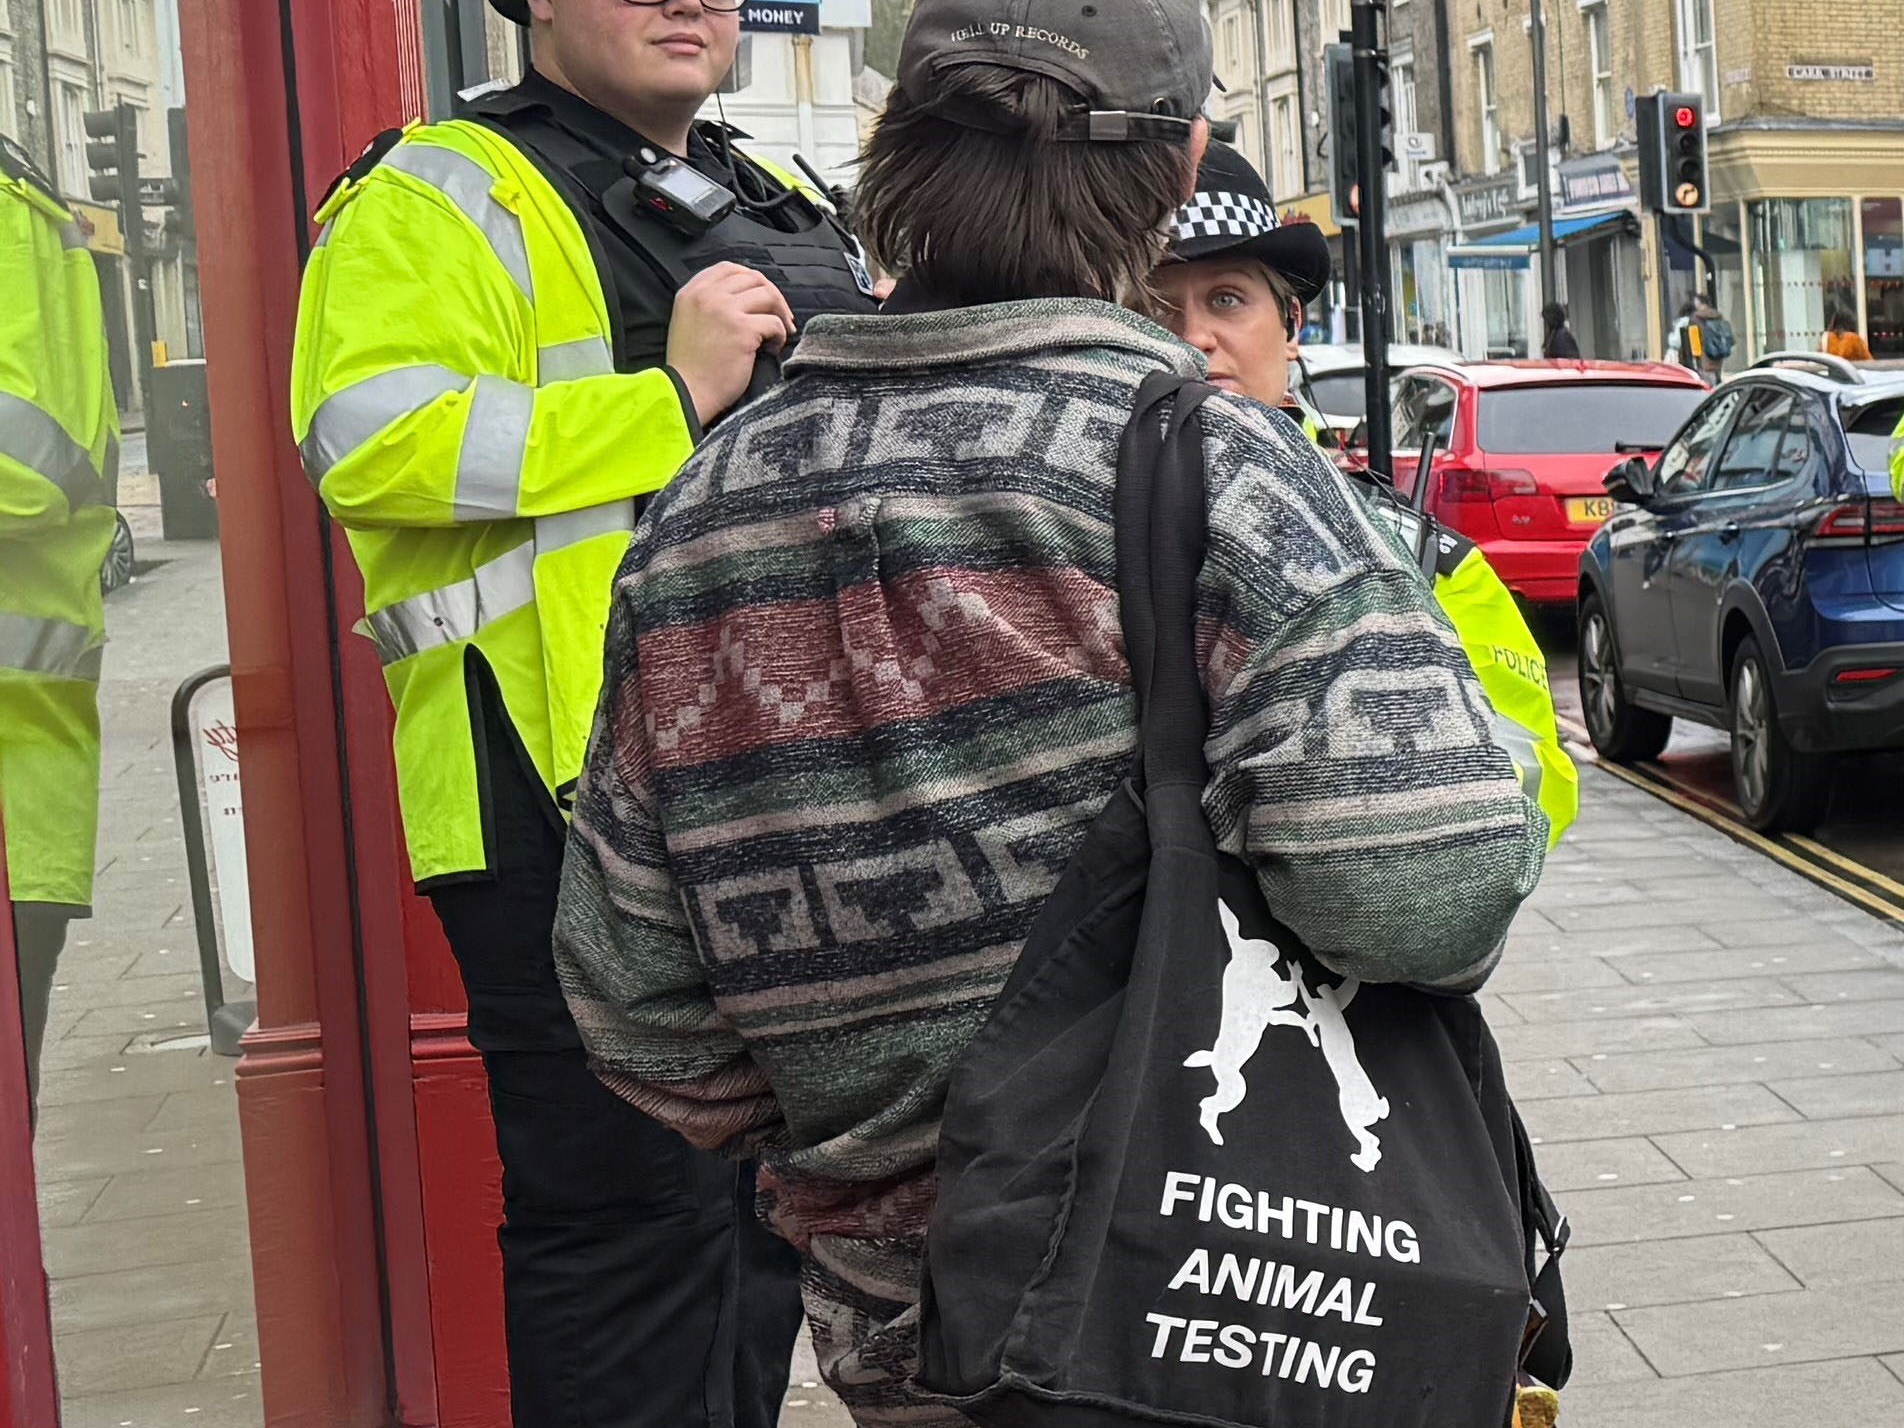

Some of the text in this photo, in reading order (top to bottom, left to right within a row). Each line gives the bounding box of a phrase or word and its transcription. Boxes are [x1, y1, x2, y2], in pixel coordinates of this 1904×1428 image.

[748, 8, 804, 25] MONEY
[990, 22, 1010, 36] UP
[1015, 25, 1090, 60] RECORDS
[1584, 499, 1615, 517] KB
[1160, 1171, 1422, 1265] FIGHTING
[1168, 1247, 1384, 1327] ANIMAL
[1144, 1312, 1377, 1394] TESTING
